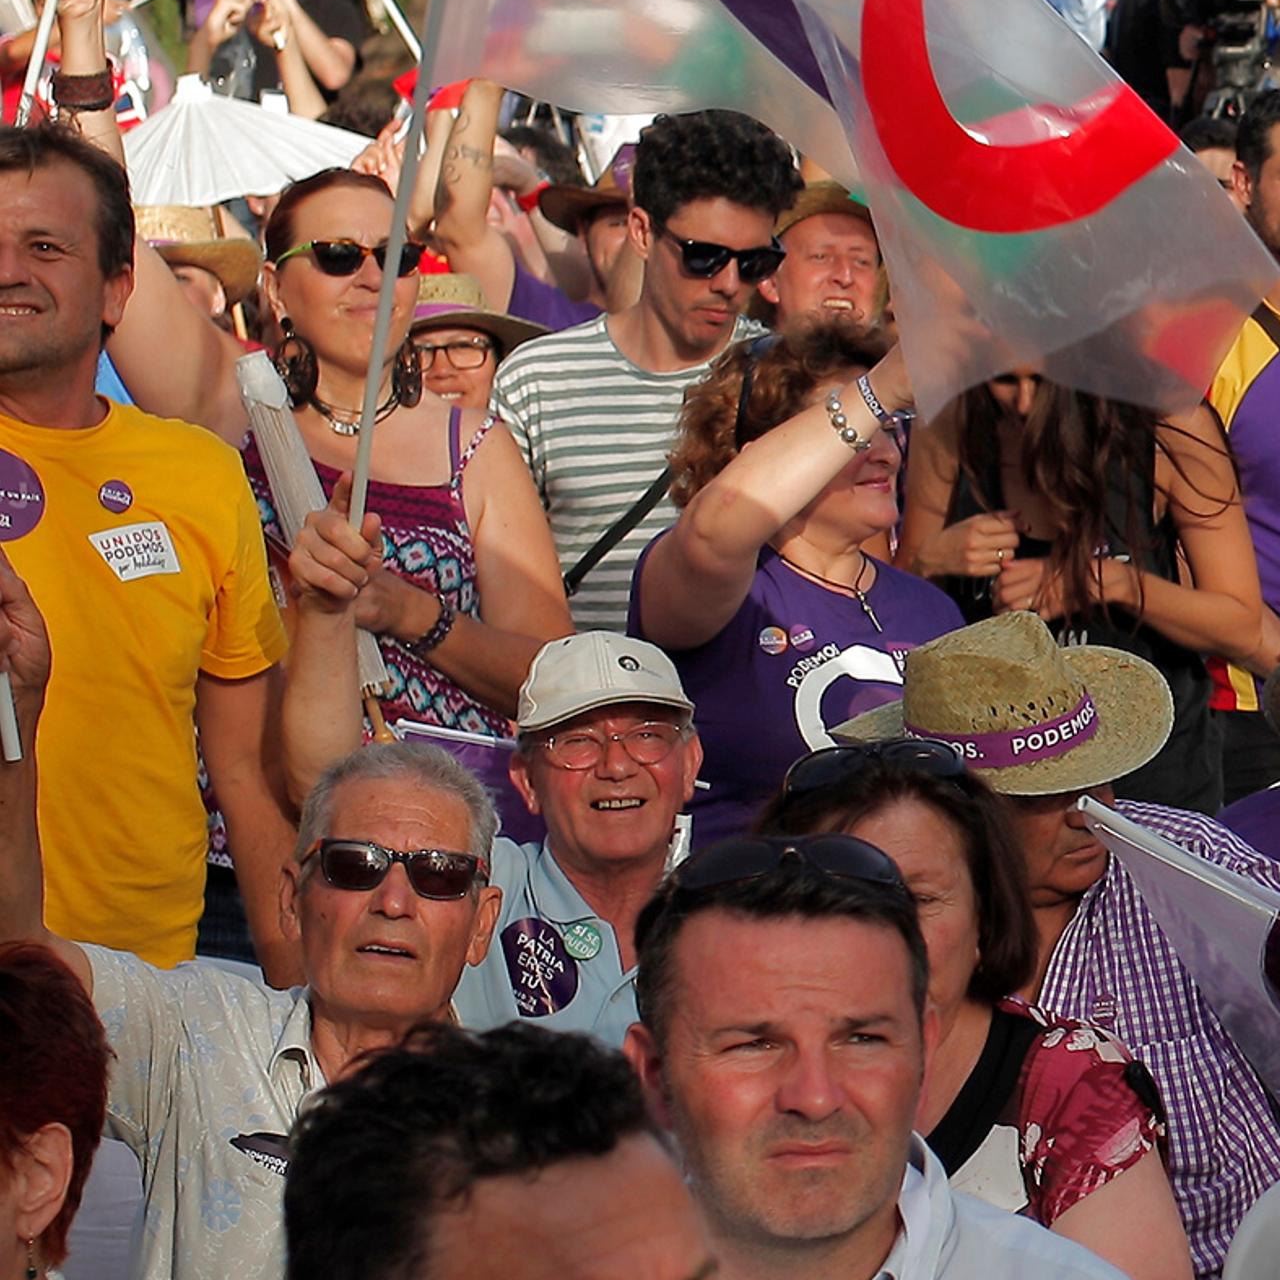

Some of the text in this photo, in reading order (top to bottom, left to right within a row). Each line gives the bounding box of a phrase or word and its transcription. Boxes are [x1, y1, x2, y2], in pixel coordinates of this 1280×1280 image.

[1011, 701, 1096, 756] PODEMOS
[517, 932, 564, 974] PATRIA
[538, 928, 555, 952] LA
[517, 951, 555, 981] ERES
